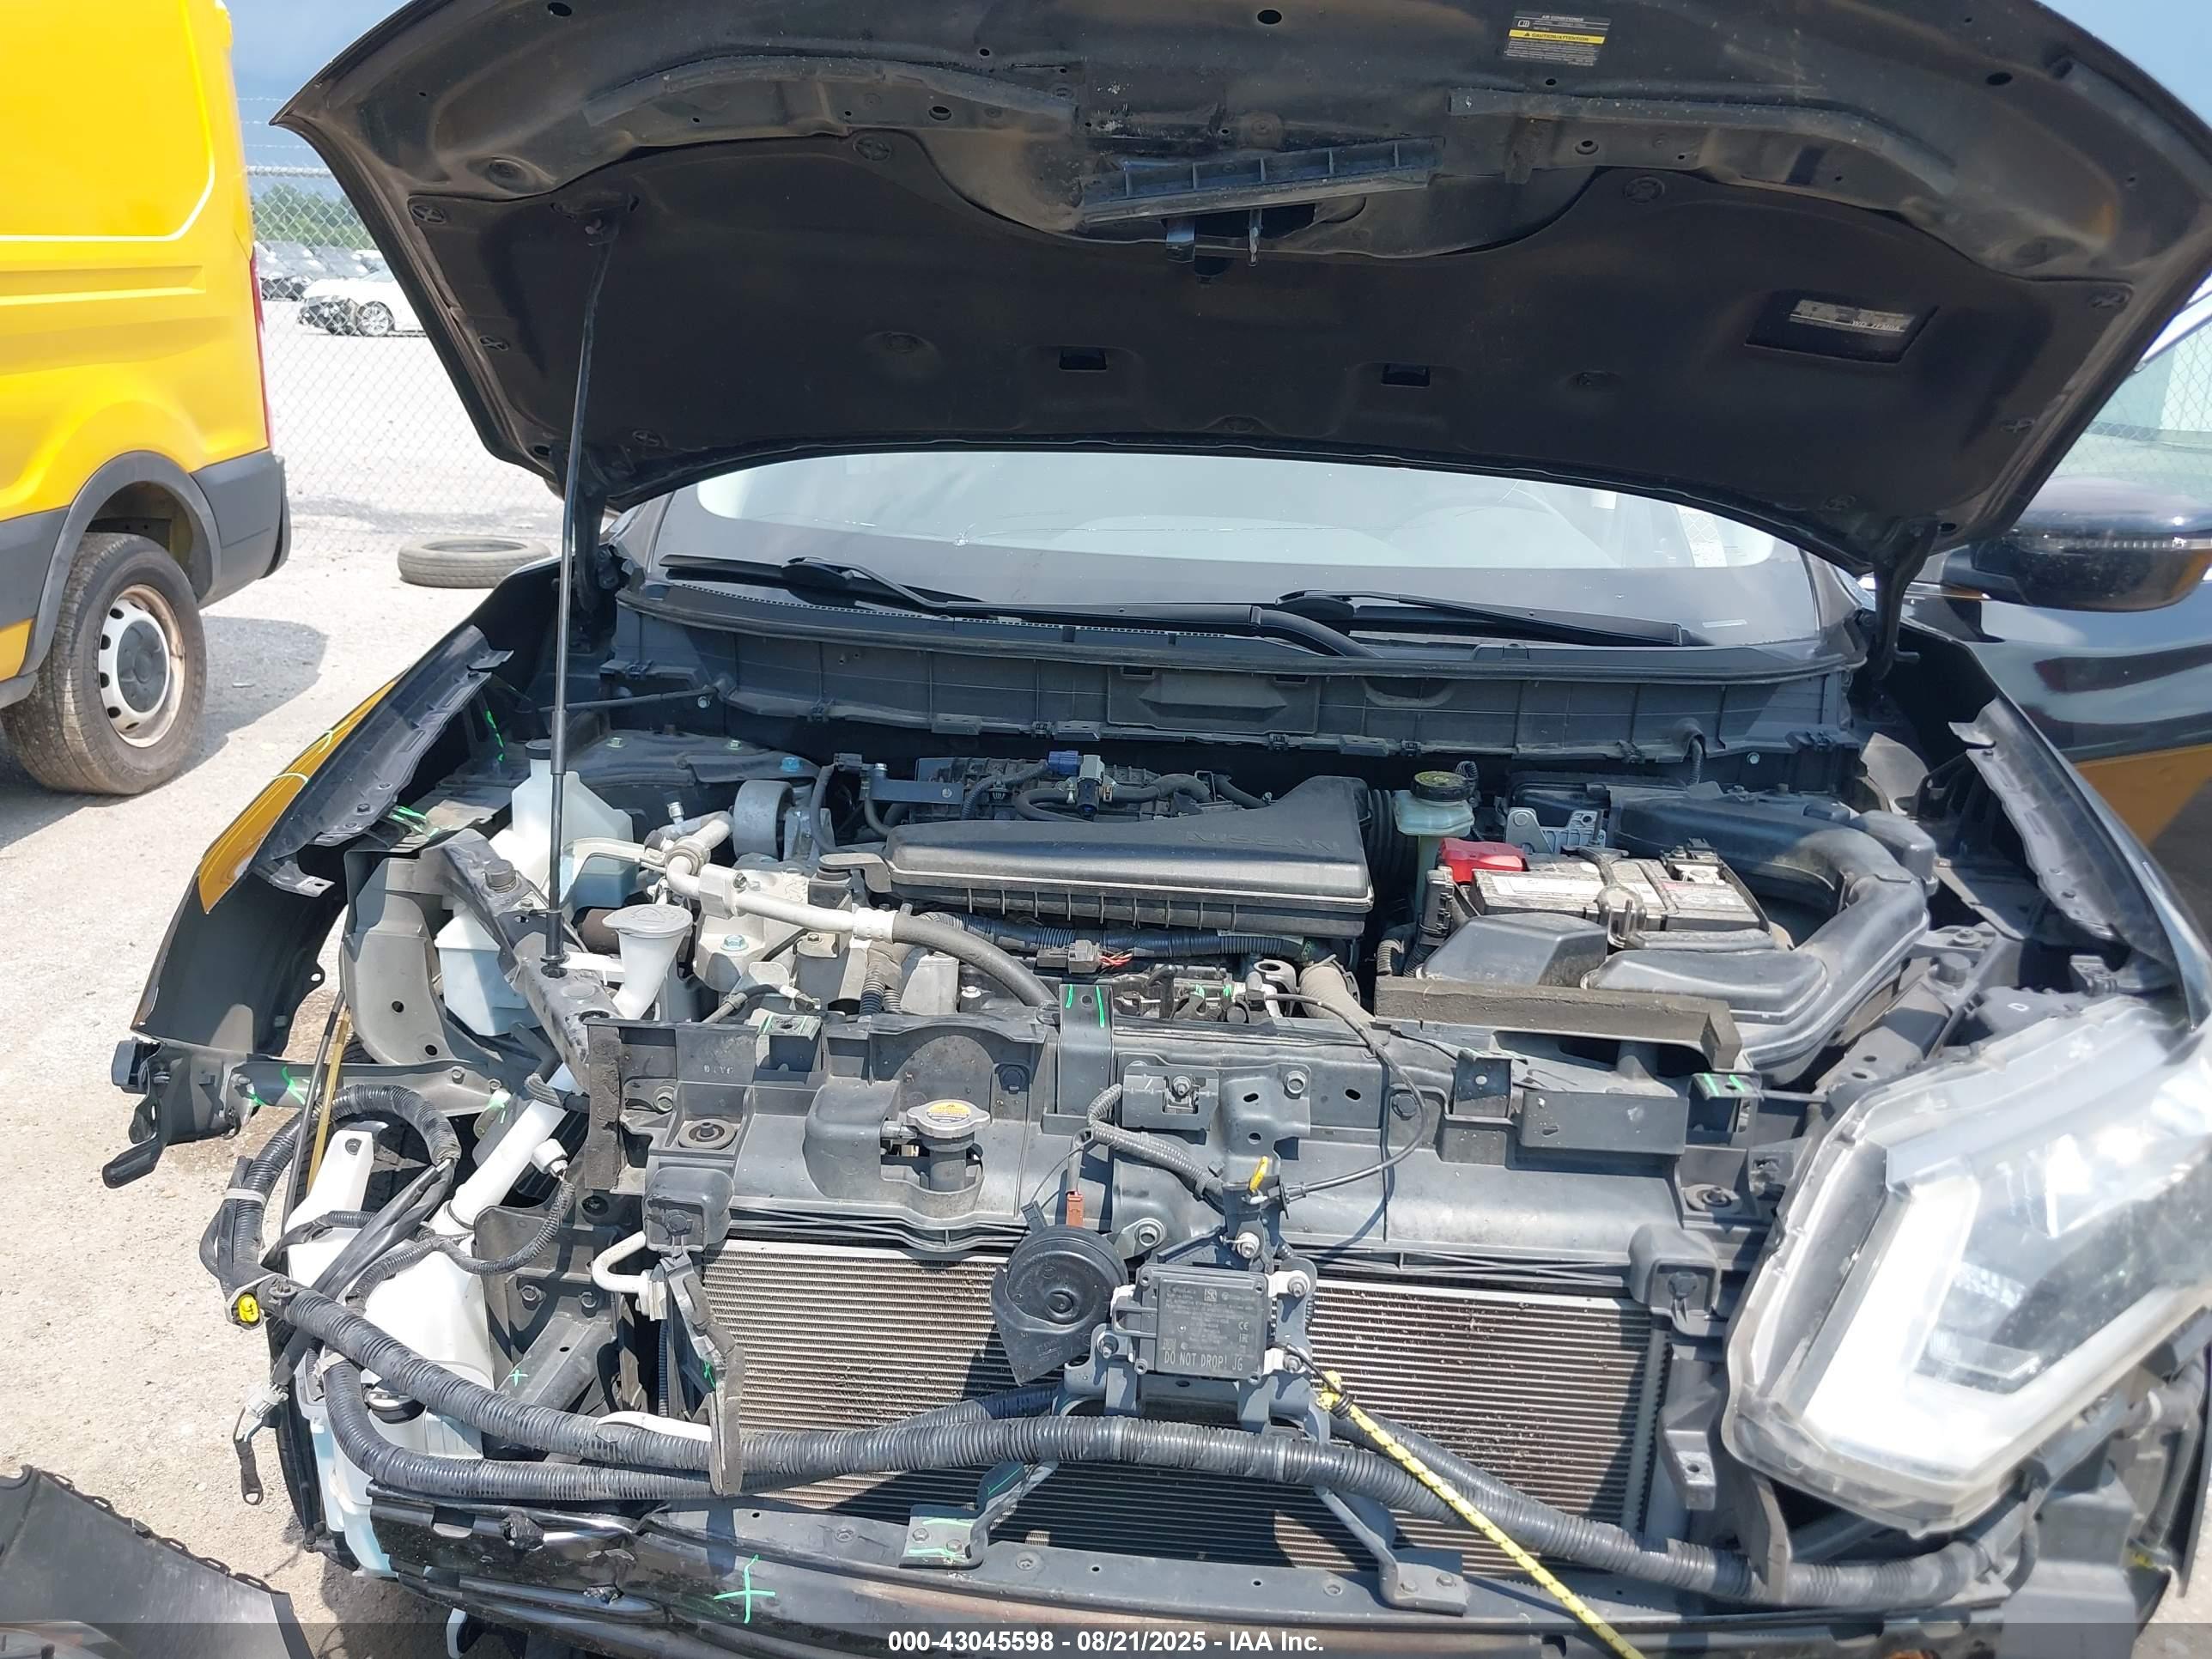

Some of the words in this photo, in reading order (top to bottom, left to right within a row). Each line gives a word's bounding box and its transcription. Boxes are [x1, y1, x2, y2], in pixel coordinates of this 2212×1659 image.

[1186, 830, 1340, 853] NISSAN
[1164, 1351, 1176, 1365] DO
[1179, 1352, 1197, 1367] NOT
[1200, 1354, 1227, 1368] DROP!
[1232, 1357, 1243, 1371] JG
